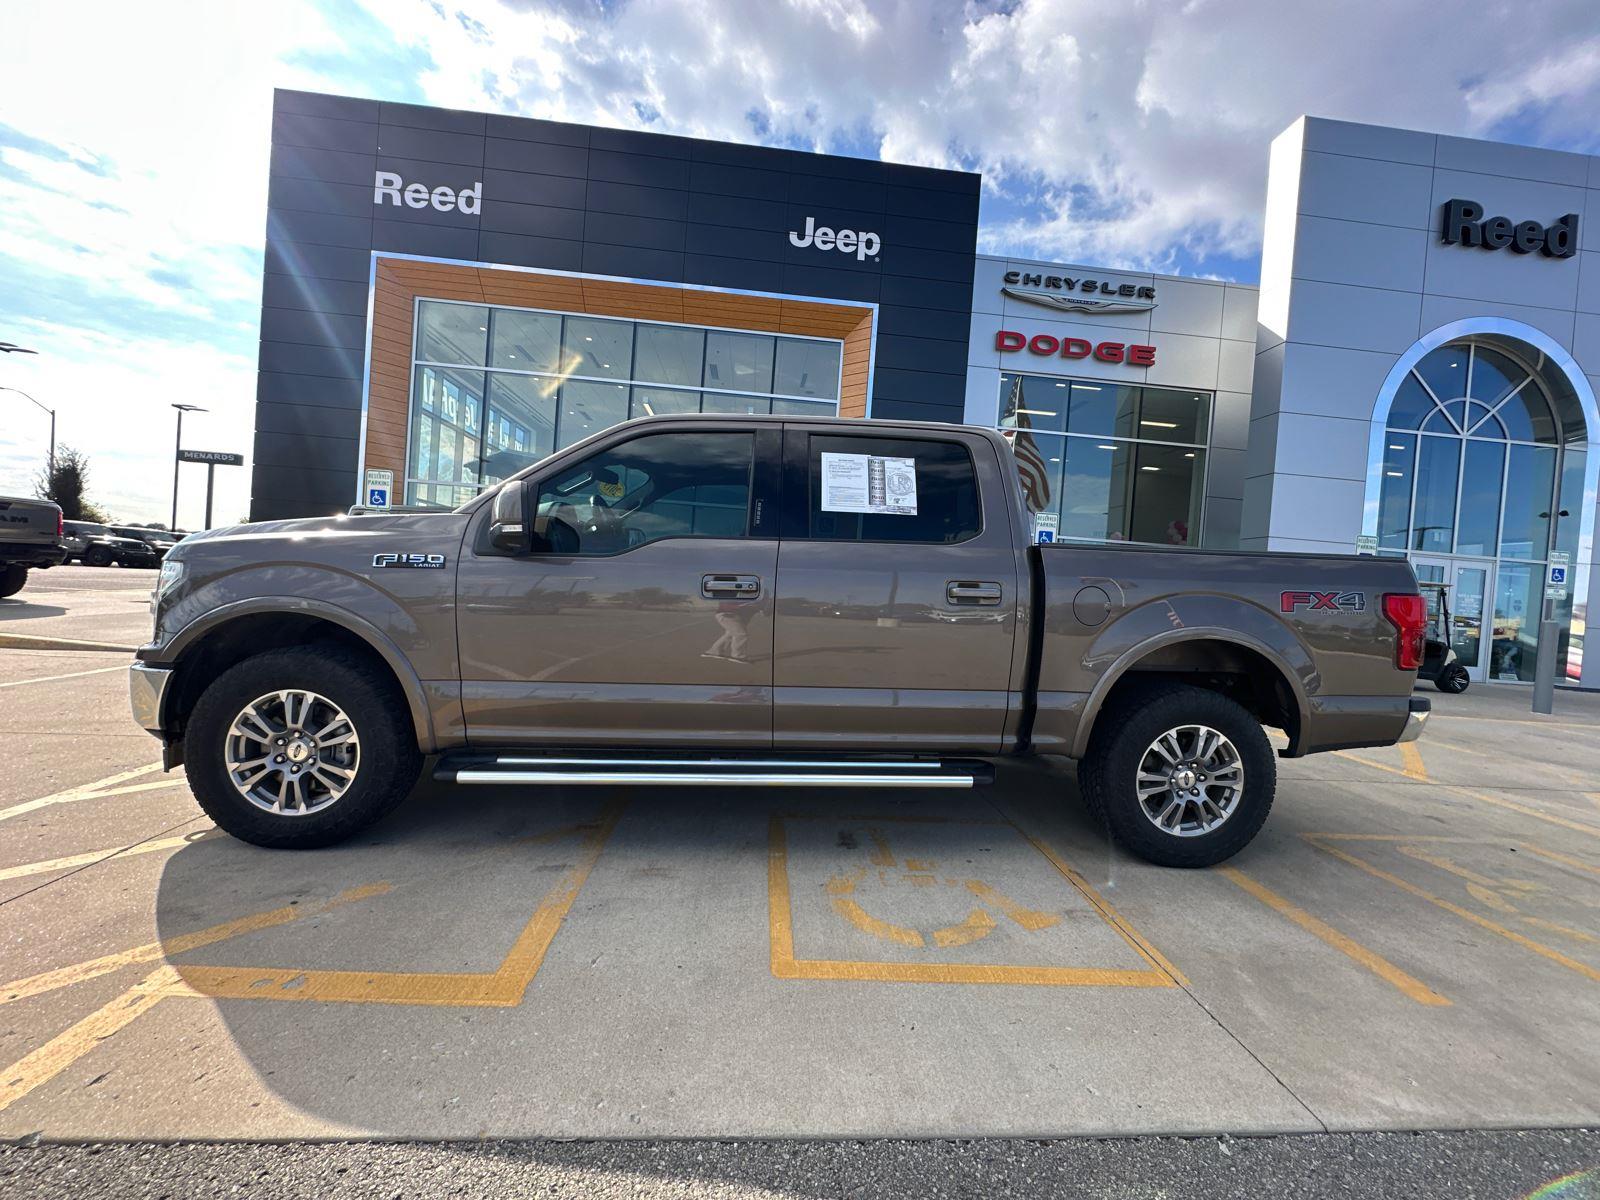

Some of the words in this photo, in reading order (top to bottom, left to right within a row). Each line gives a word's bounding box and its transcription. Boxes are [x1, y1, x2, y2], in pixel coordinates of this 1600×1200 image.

[374, 171, 482, 215] Reed
[789, 217, 880, 261] Jeep
[1441, 198, 1579, 258] Reed
[1003, 271, 1156, 299] CHRYSLER
[995, 330, 1157, 367] DODGE
[184, 451, 235, 461] MENARDS
[368, 472, 390, 480] RESERVED
[1037, 514, 1057, 522] RESERVED
[1280, 590, 1366, 613] FX4
